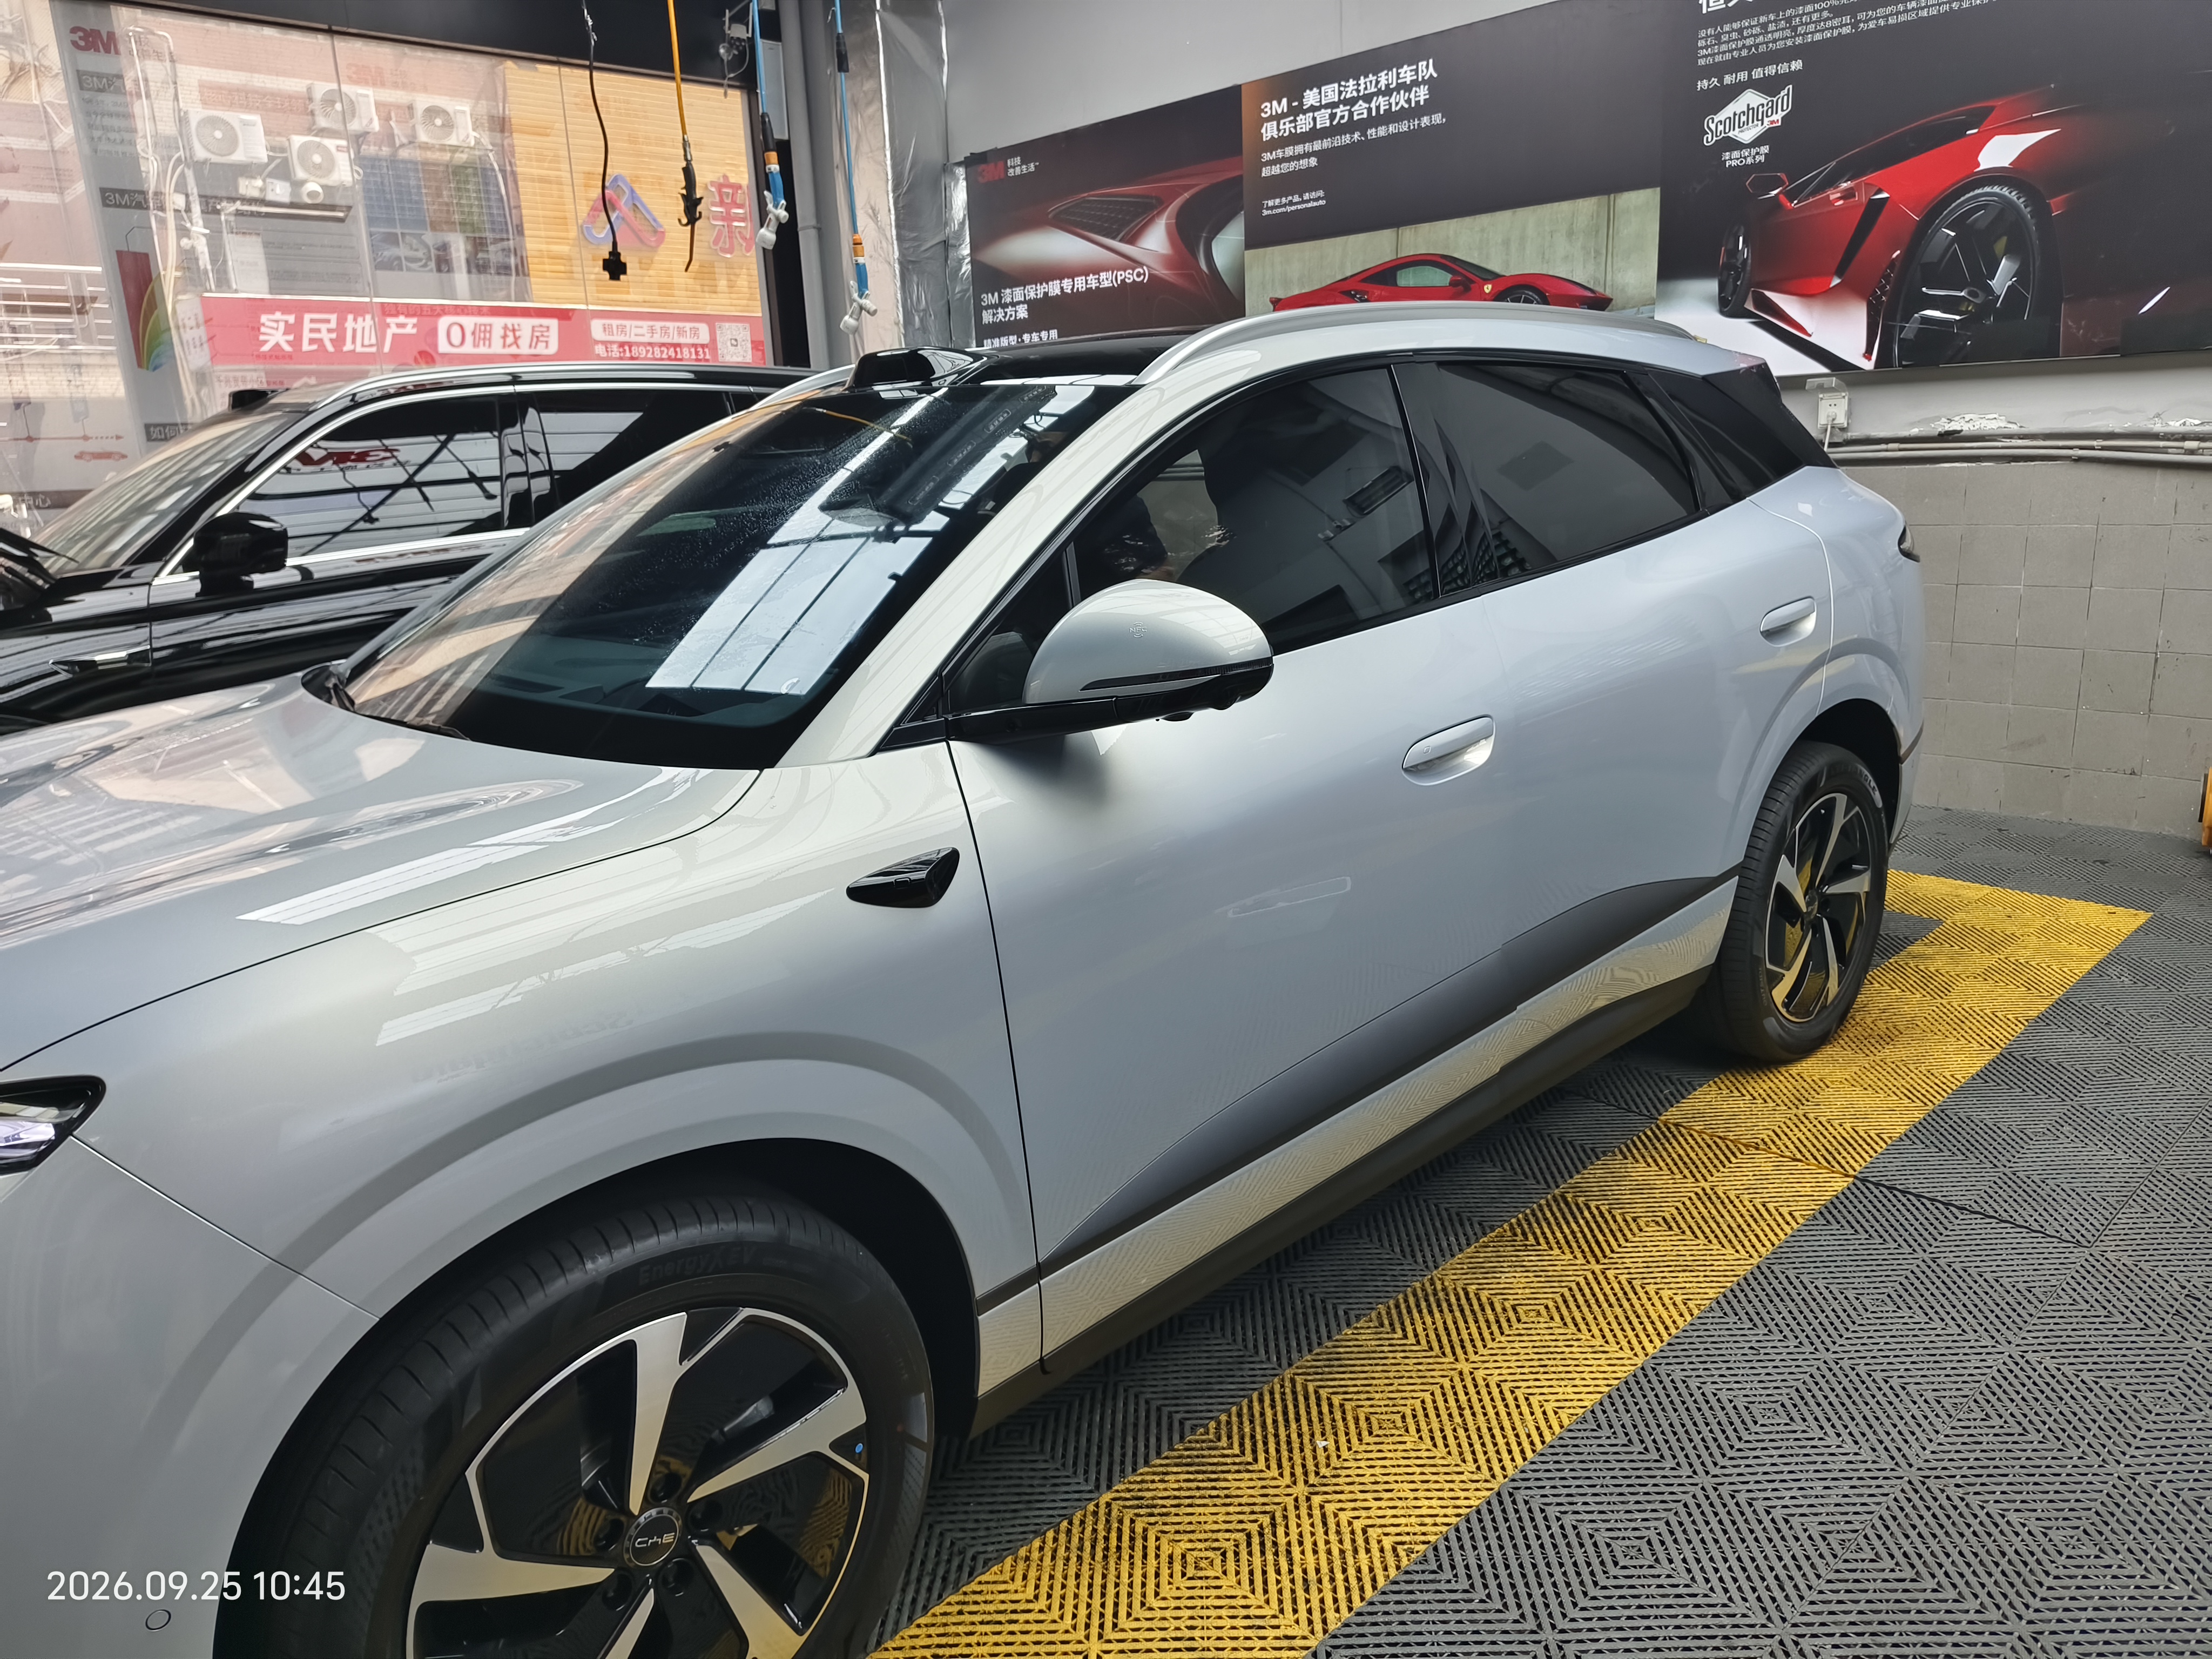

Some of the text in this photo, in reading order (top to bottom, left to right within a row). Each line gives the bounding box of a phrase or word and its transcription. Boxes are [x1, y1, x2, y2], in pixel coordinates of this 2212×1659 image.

[69, 26, 121, 55] 3M
[1696, 59, 1803, 91] 持久 耐用 值得信赖
[1260, 98, 1287, 118] 3M
[1303, 58, 1438, 109] 美国法拉利车队
[1261, 85, 1429, 141] 俱乐部官方合作伙伴
[1705, 86, 1791, 145] Scotchgard
[1007, 157, 1021, 168] 科技
[1722, 145, 1770, 160] 漆面保护膜
[1725, 154, 1765, 168] PRO系列
[977, 161, 1004, 183] 3M
[1261, 157, 1318, 178] 超越您的想象
[1262, 200, 1326, 216] 3m.com/personalauto
[981, 266, 1149, 306] 3M 漆面保护膜专用车型(PSC)
[982, 304, 1028, 325] 解决方案
[259, 311, 417, 353] 实民地产
[446, 322, 551, 350] 0佣找房
[602, 323, 700, 340] 租房/二手房/新房
